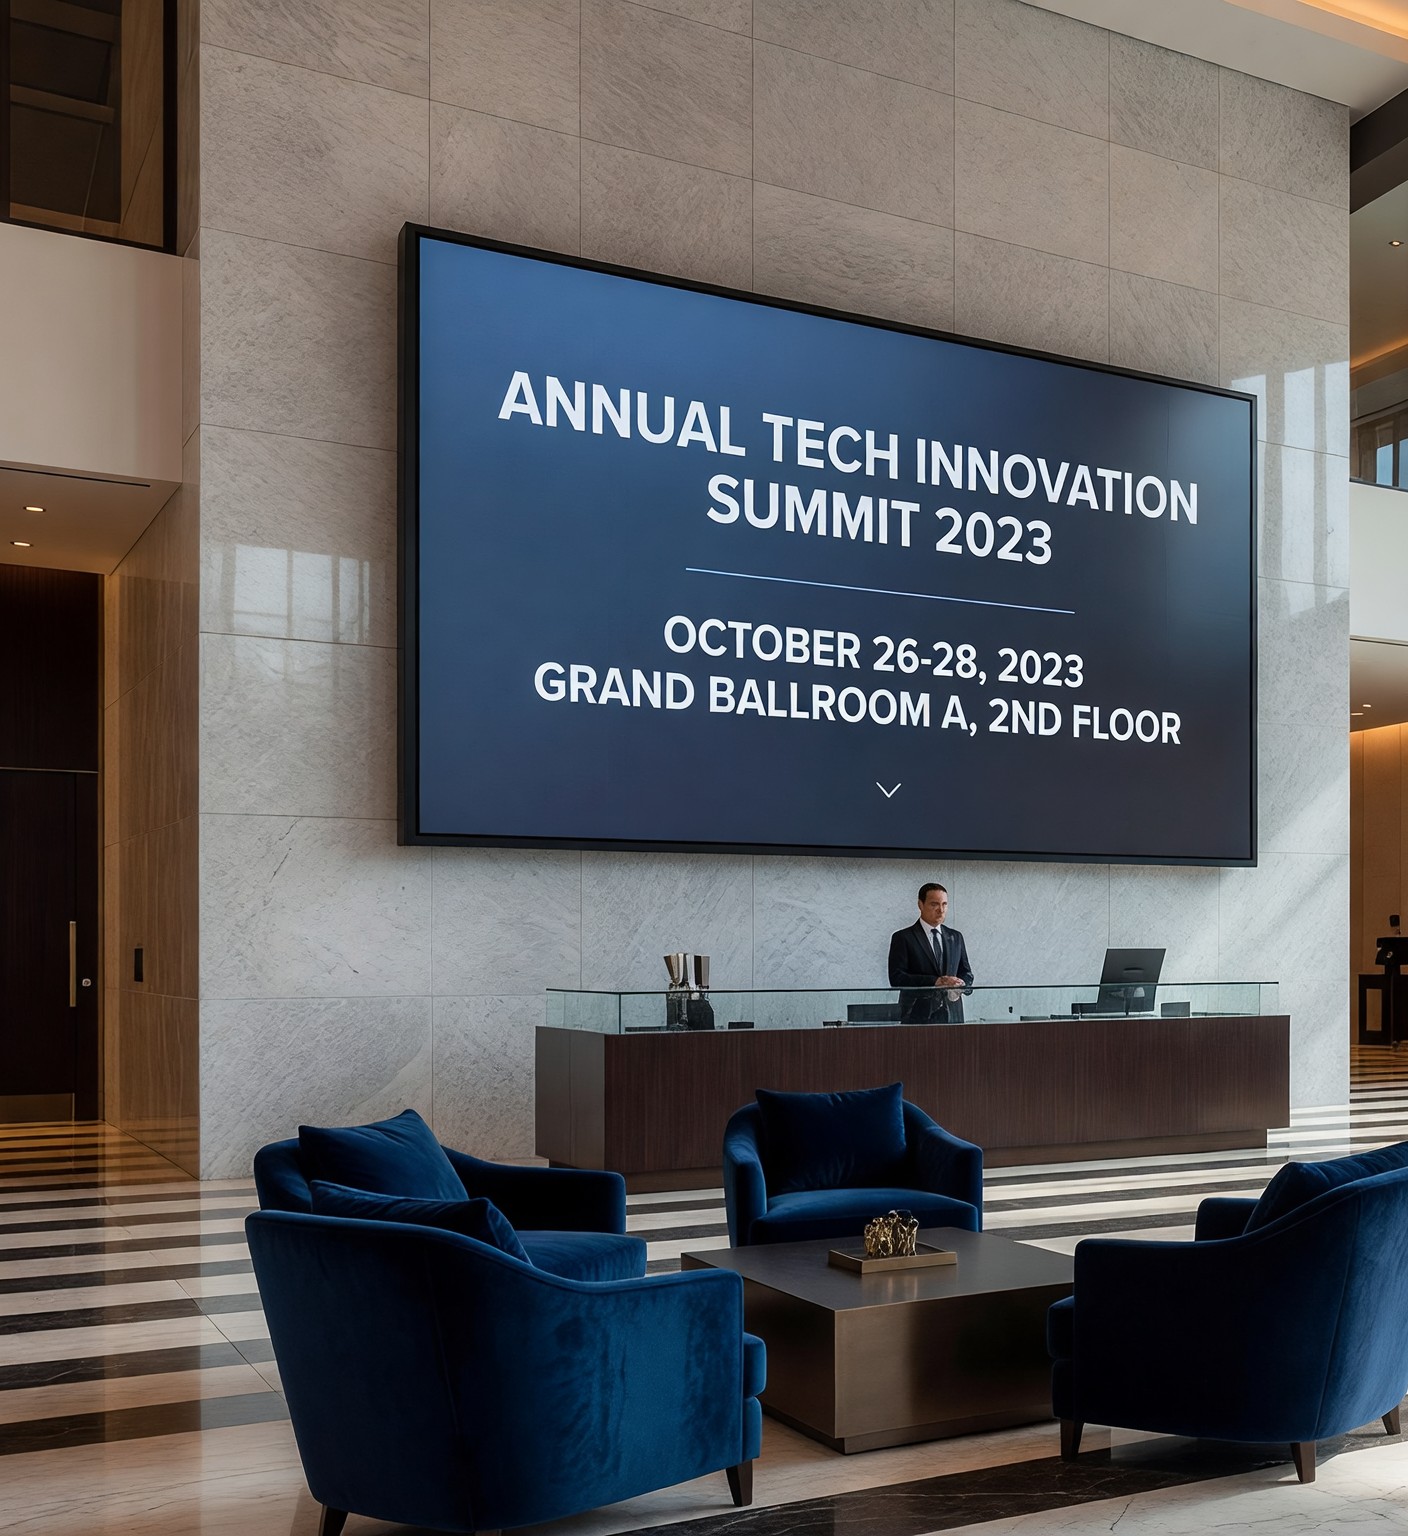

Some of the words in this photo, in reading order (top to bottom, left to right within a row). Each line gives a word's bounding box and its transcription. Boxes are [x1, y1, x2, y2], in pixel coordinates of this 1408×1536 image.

[497, 370, 746, 457] ANNUAL
[762, 412, 899, 480] TECH
[916, 438, 1198, 525] INNOVATION
[706, 474, 921, 548] SUMMIT
[934, 506, 1052, 565] 2023
[663, 615, 861, 669] OCTOBER
[872, 635, 987, 686] 26-28,
[997, 647, 1084, 688] 2023
[534, 661, 695, 710] GRAND
[709, 675, 930, 728] BALLROOM
[941, 694, 978, 737] A,
[988, 697, 1062, 736] 2ND
[1073, 704, 1181, 745] FLOOR
